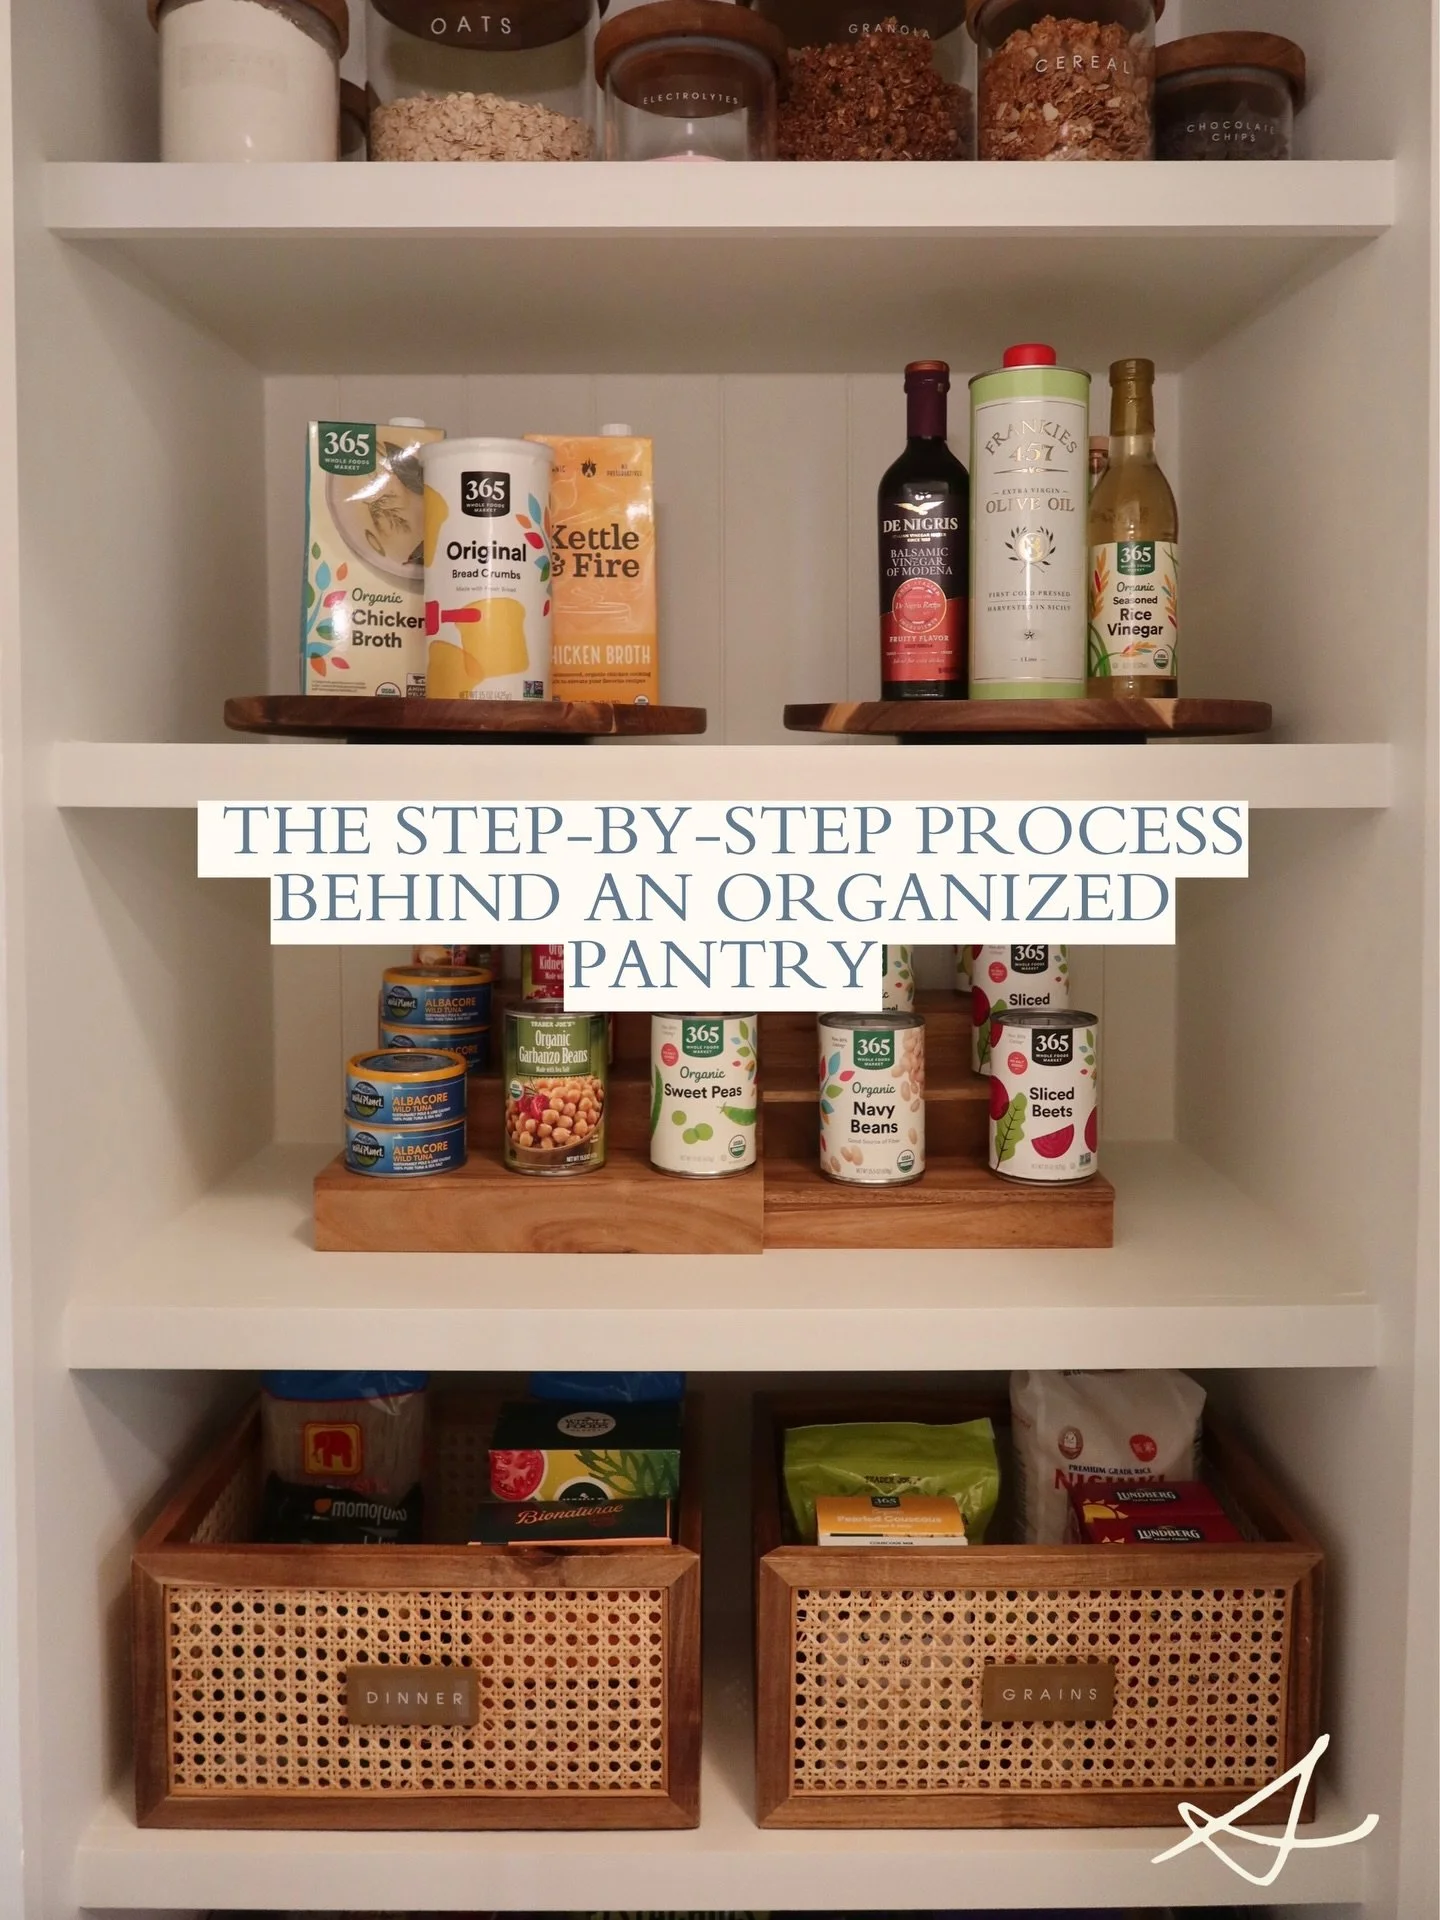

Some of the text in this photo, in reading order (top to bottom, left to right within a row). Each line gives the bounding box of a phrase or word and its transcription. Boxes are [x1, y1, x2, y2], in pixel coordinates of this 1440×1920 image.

[431, 15, 512, 35] OATS
[847, 22, 931, 40] GRANOLA
[1034, 54, 1131, 75] CEREAL
[643, 91, 739, 106] ELECTROLYTES
[1186, 120, 1275, 136] CHOCOLATE
[1211, 132, 1257, 143] CHIPS
[324, 430, 370, 457] 365
[985, 419, 1078, 455] FRANKIES
[1009, 442, 1054, 462] 457
[465, 477, 505, 501] 365
[1001, 487, 1028, 495] EXTRA
[985, 497, 1076, 513] OLIVE OIL
[883, 517, 959, 533] DE NIGRIS
[552, 523, 640, 550] Kettle
[446, 540, 527, 564] Original
[890, 547, 949, 558] BALSAMIC
[1120, 545, 1152, 563] 365
[552, 552, 640, 577] & Fire
[892, 557, 947, 567] VINEGAR
[452, 568, 521, 580] Bread Crumbs
[886, 566, 953, 577] OF MODENA
[1116, 581, 1155, 596] Oranic
[352, 587, 403, 606] Organic
[1120, 608, 1152, 621] Rice
[1107, 624, 1164, 638] Vinegar
[352, 630, 402, 648] Broth
[889, 635, 916, 643] FRUITY
[553, 645, 651, 665] HICKEN BROTH
[1014, 944, 1045, 961] 365
[425, 997, 477, 1007] ALBACORE
[1009, 993, 1050, 1006] Sliced
[535, 1030, 571, 1049] Organic
[686, 1025, 720, 1044] 365
[857, 1036, 891, 1056] 365
[1035, 1033, 1070, 1052] 365
[519, 1046, 588, 1064] Garbanzo Beans
[680, 1066, 726, 1083] Organic
[664, 1083, 742, 1099] Sweet Peas
[852, 1082, 896, 1097] Organic
[1029, 1087, 1075, 1100] Sliced
[393, 1092, 449, 1106] ALBACORE
[393, 1105, 411, 1113] WILD
[853, 1101, 896, 1119] Navy
[1032, 1104, 1073, 1117] Beets
[851, 1119, 898, 1133] Beans
[393, 1141, 449, 1155] ALBACORE
[393, 1153, 433, 1162] WILD TUNA
[1068, 1464, 1106, 1474] PREMIUM
[1116, 1490, 1177, 1500] LUNDBERG
[515, 1503, 624, 1525] Bionaturae
[837, 1515, 942, 1524] Pearled Couscous
[1137, 1529, 1201, 1540] LUNDBERG
[366, 1691, 463, 1706] DINNER
[1002, 1688, 1098, 1701] GRAINS
